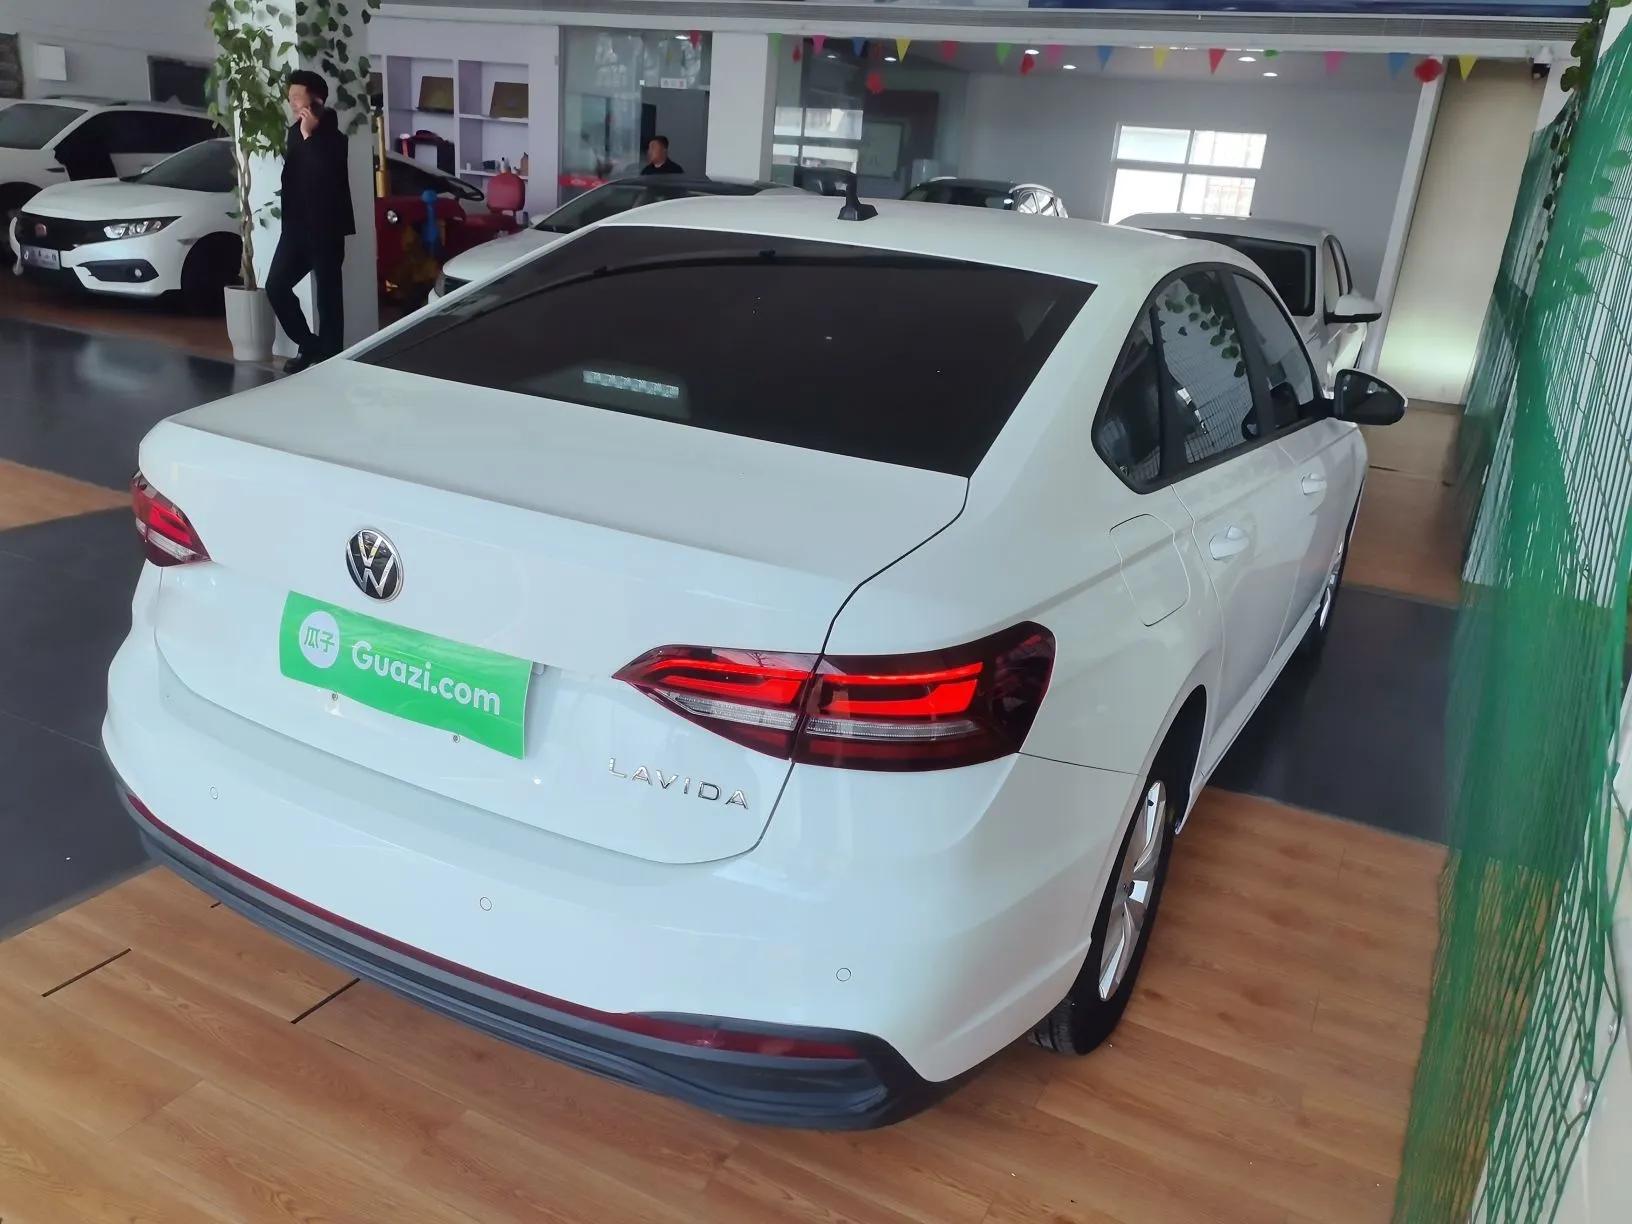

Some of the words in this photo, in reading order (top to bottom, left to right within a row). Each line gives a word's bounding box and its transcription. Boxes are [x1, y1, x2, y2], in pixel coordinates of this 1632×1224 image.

[303, 625, 335, 653] 瓜子
[351, 640, 501, 716] Guazi.com
[608, 757, 749, 810] LAVIDA
